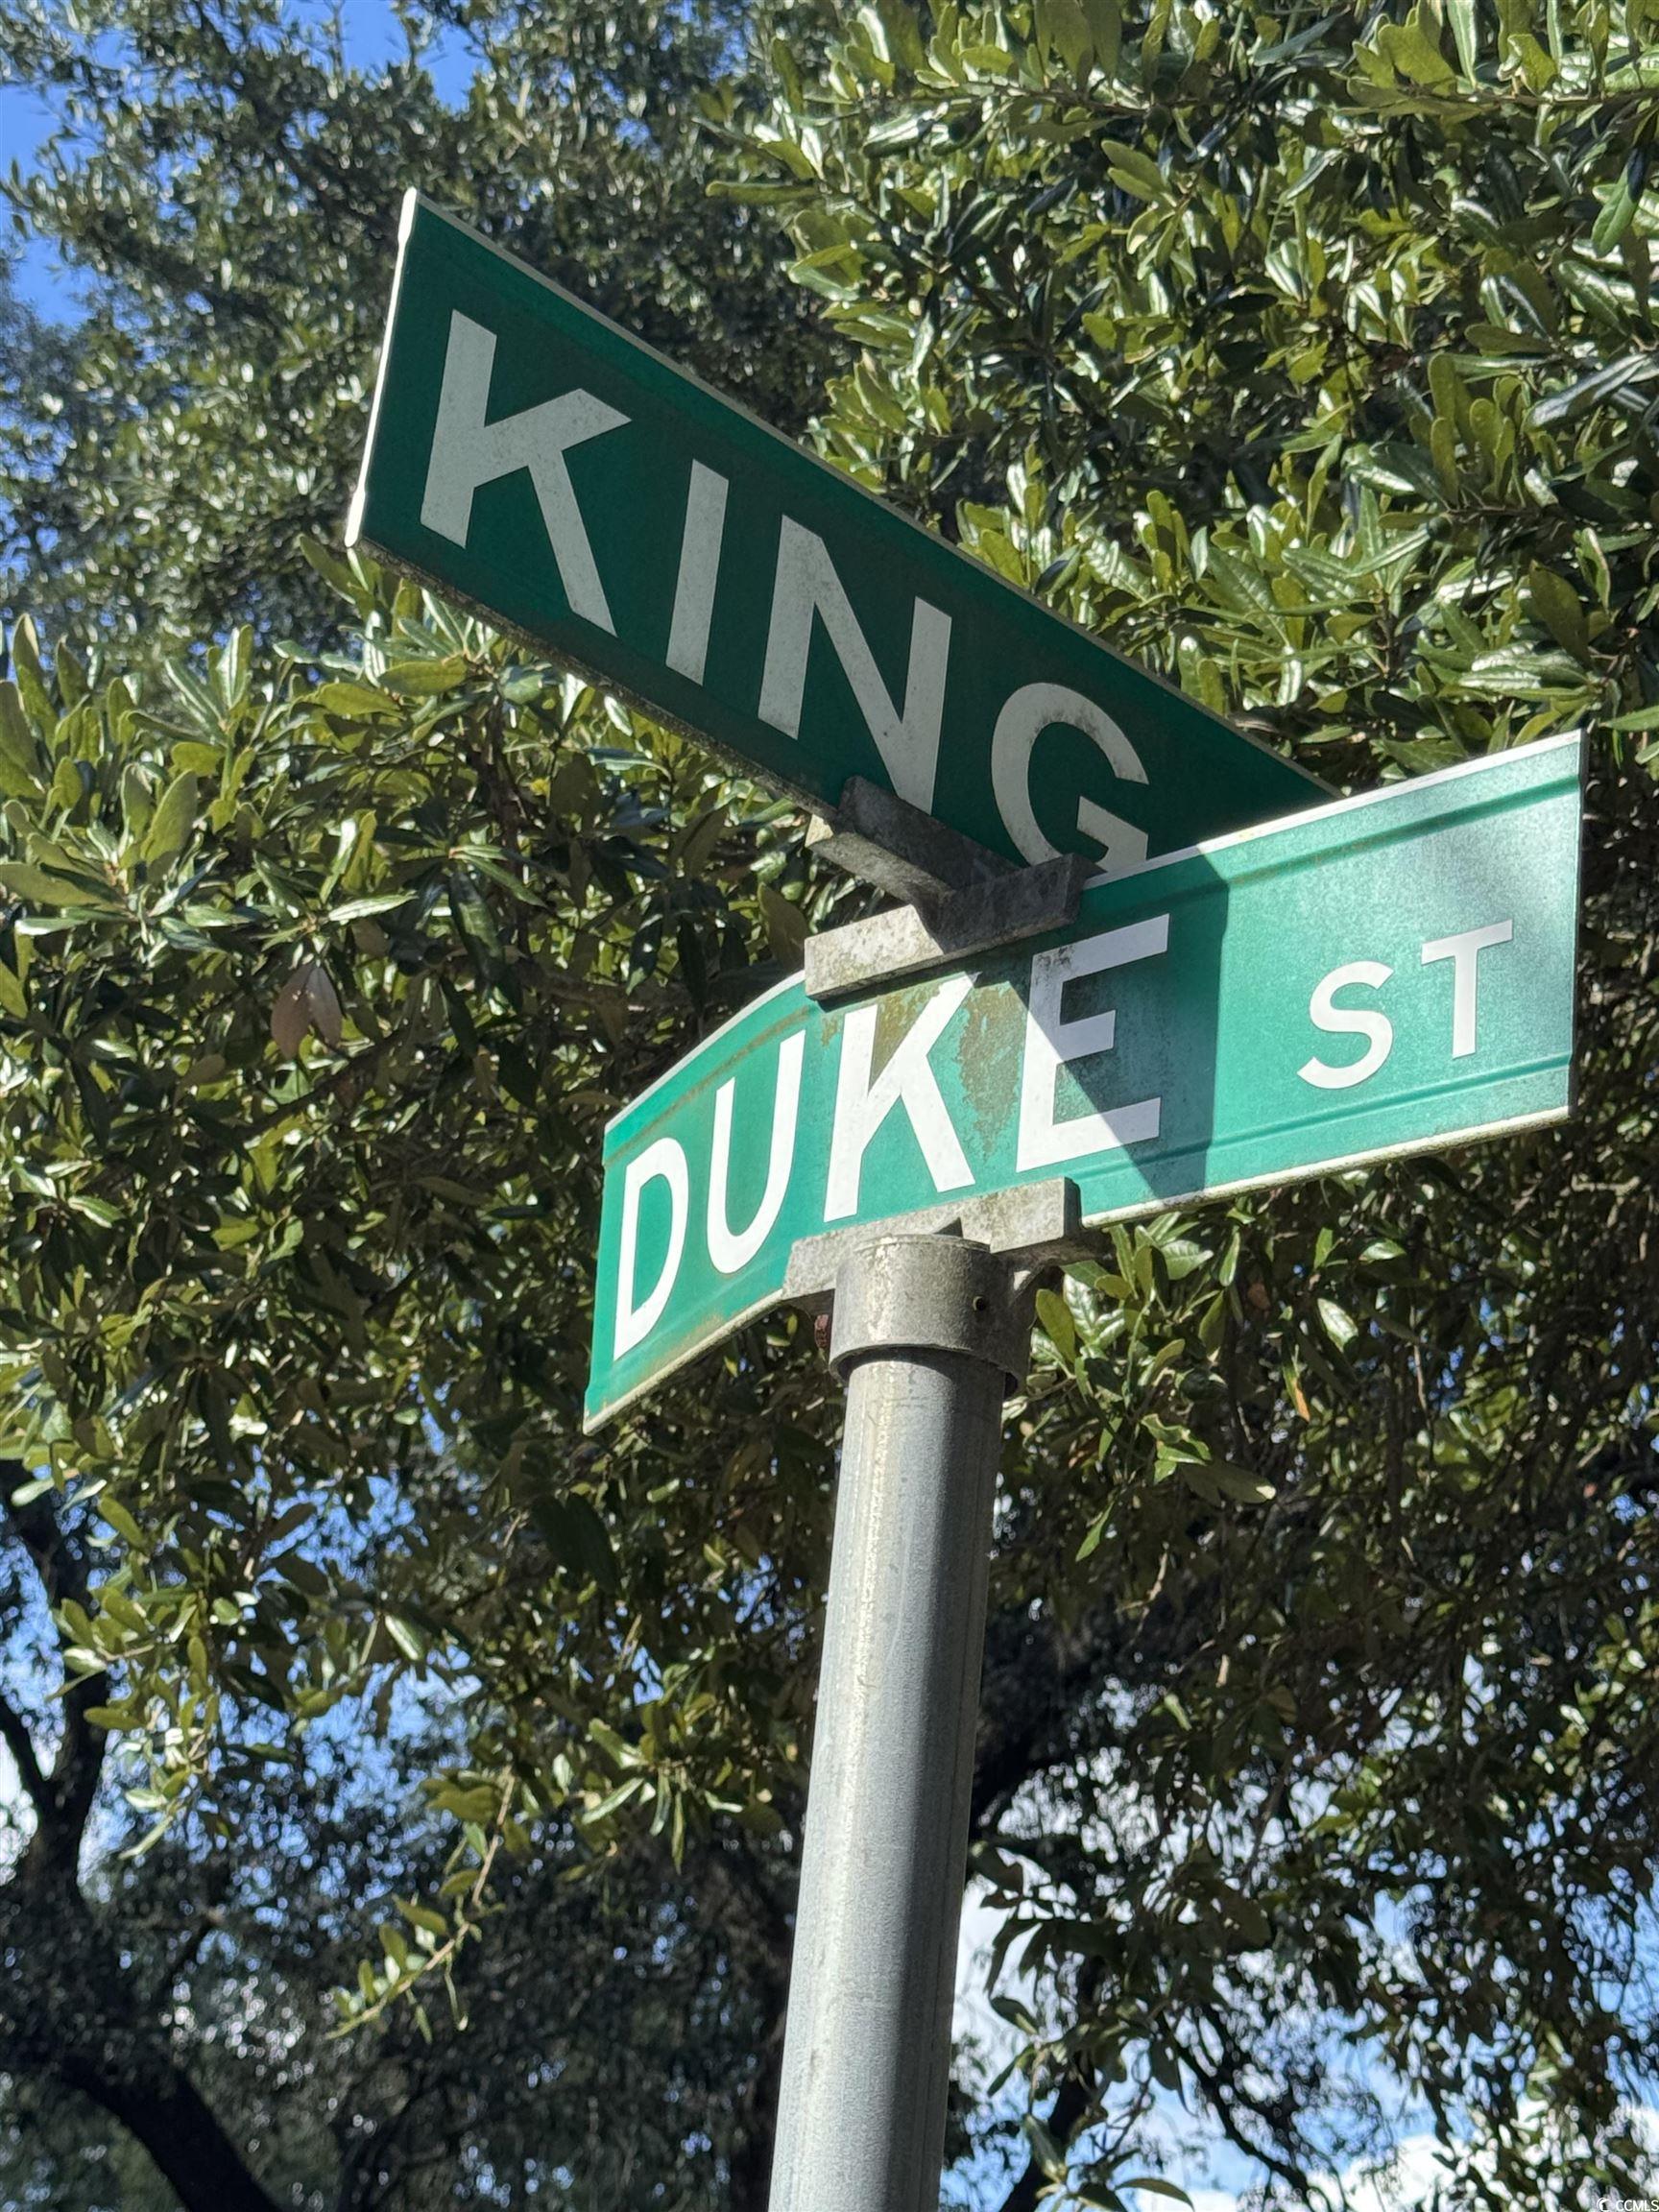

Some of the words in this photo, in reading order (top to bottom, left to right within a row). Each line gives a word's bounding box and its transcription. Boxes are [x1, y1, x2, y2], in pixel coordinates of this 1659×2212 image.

[421, 310, 1148, 873] KING
[614, 914, 1170, 1359] DUKE
[1297, 919, 1513, 1090] ST
